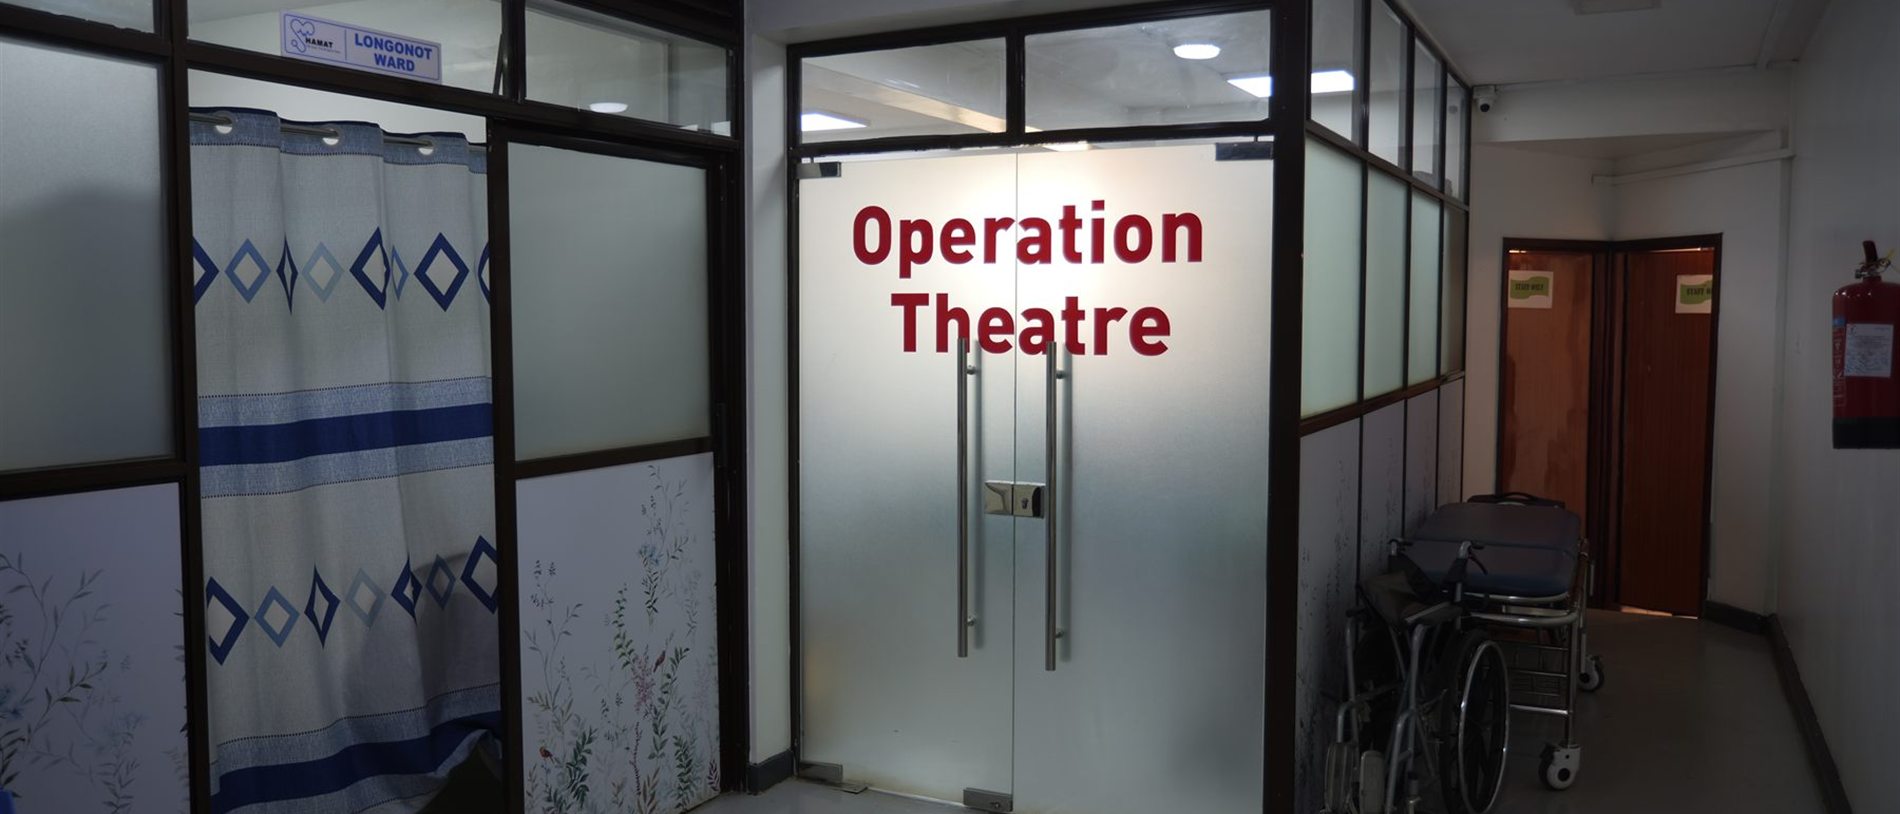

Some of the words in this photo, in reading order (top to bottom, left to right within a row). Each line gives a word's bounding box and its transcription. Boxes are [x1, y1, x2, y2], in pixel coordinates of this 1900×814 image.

[305, 37, 334, 48] HAMAT
[354, 33, 433, 60] LONGONOT
[374, 53, 415, 72] WARD
[853, 199, 1203, 279] Operation
[1686, 287, 1704, 296] STAFF
[891, 292, 1171, 356] Theatre
